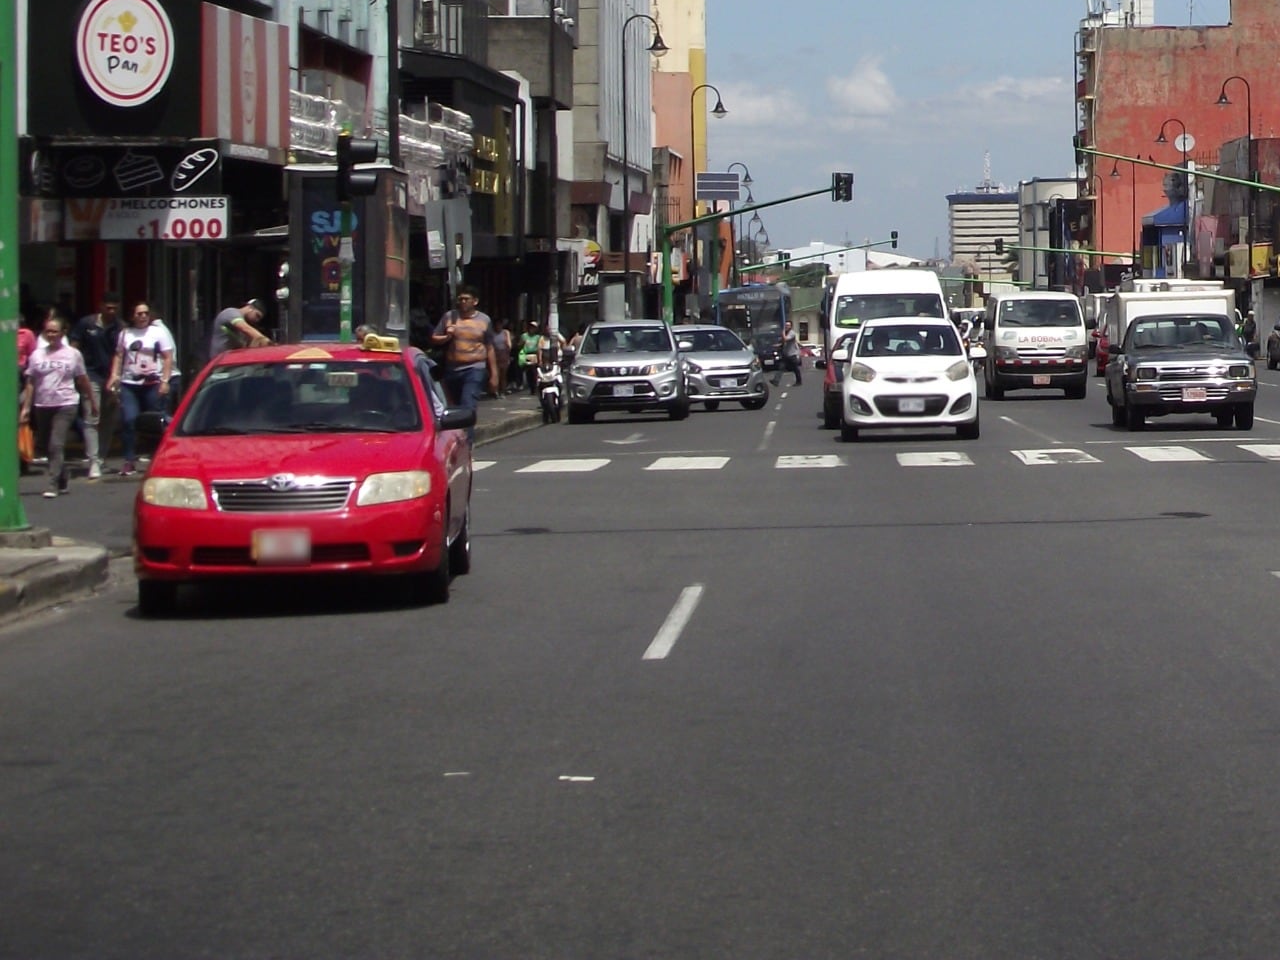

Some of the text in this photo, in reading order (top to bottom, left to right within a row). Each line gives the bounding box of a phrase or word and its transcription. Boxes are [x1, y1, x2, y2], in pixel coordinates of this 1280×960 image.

[97, 32, 156, 56] TEO'S
[107, 55, 139, 74] Pan
[121, 198, 226, 210] MELCOCHONES
